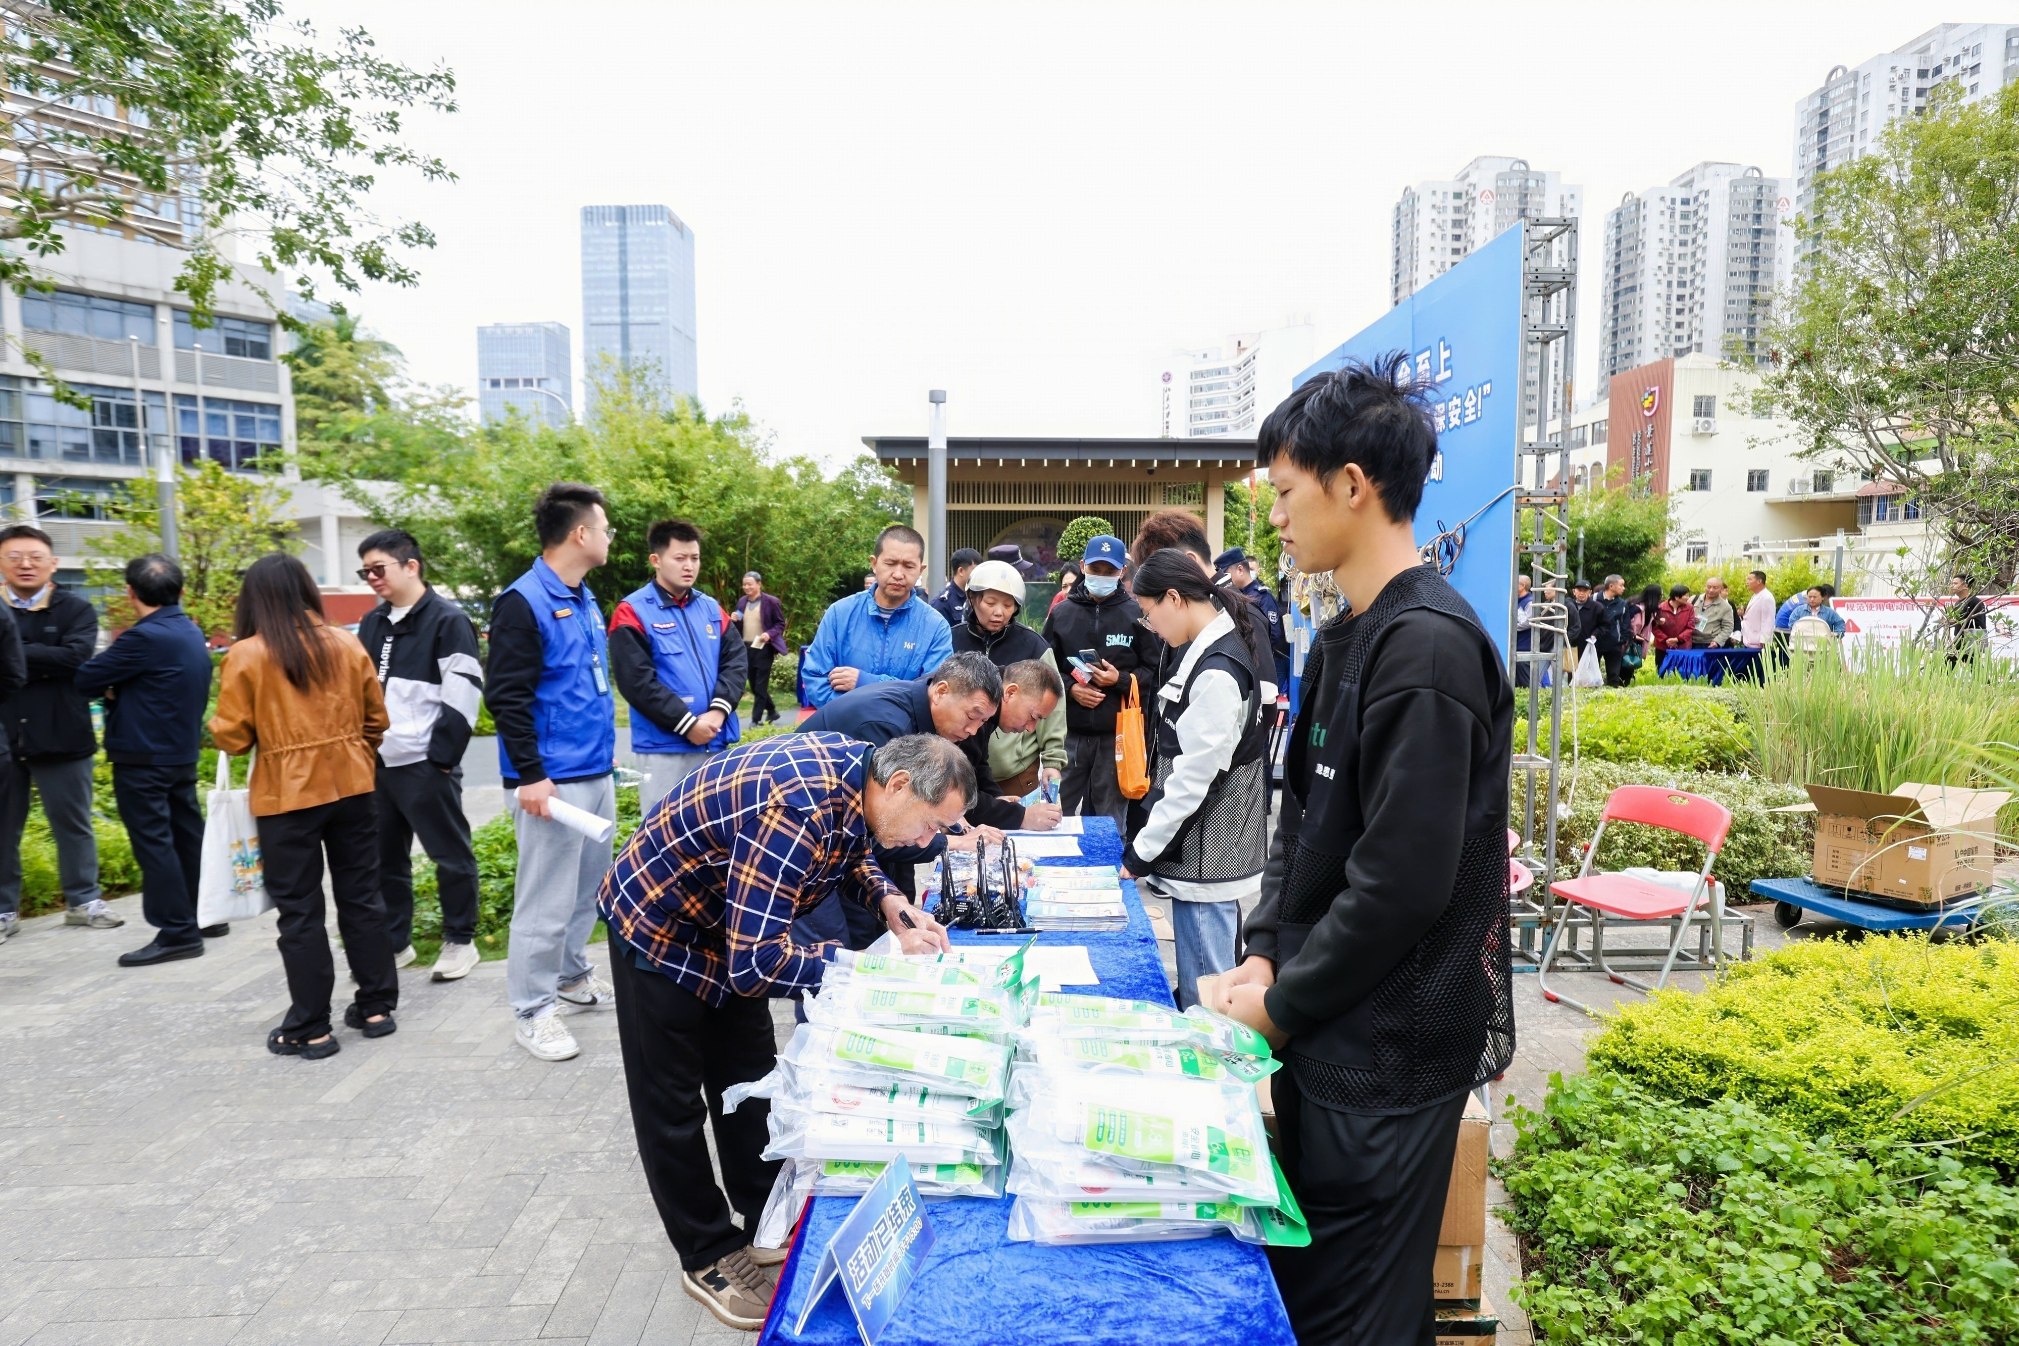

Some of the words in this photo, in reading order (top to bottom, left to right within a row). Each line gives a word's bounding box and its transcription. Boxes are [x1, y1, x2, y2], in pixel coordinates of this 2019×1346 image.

[1427, 382, 1491, 432] 保安全!”
[1424, 450, 1443, 485] 动
[847, 1183, 917, 1293] 活动已结束
